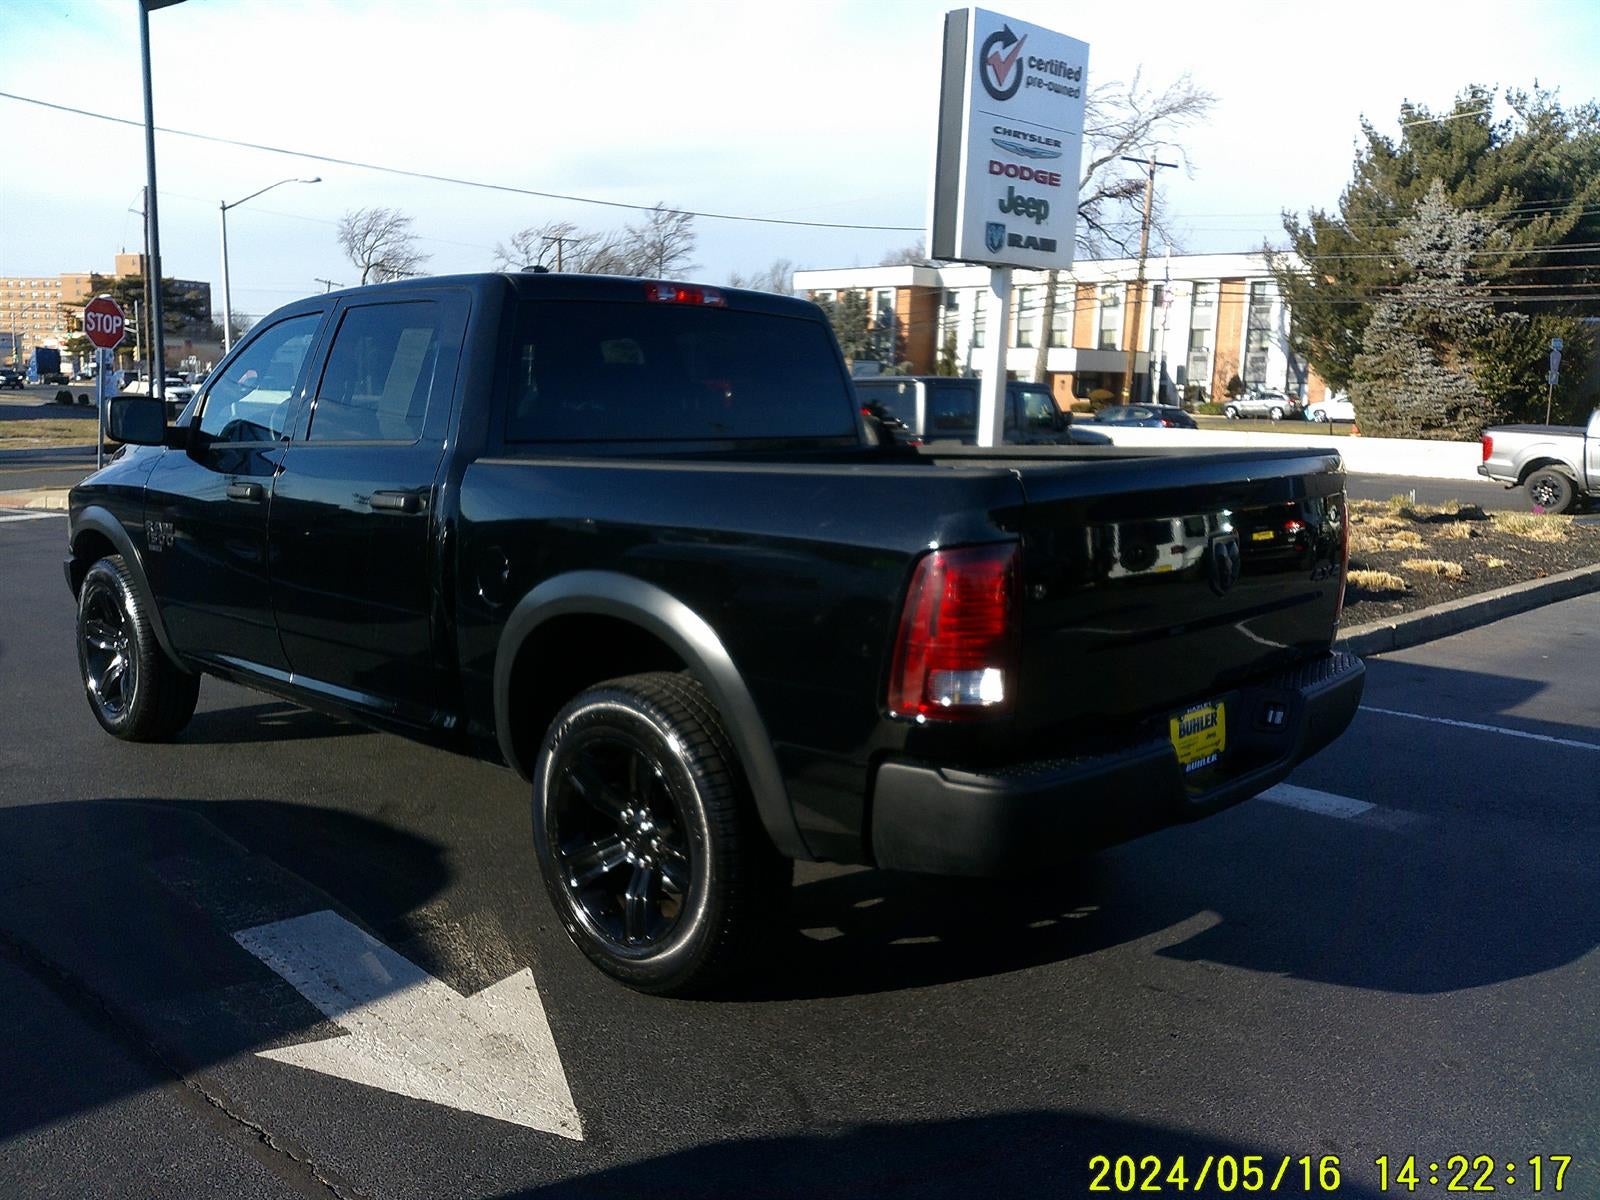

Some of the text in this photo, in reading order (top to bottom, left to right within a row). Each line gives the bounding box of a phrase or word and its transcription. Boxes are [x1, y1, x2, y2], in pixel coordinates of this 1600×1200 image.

[1027, 55, 1082, 82] certified
[1025, 74, 1080, 99] pre-owned
[993, 126, 1062, 148] CHRYSLER
[988, 159, 1061, 187] DODGE
[998, 186, 1049, 224] Jeep
[1007, 232, 1057, 252] RAM
[86, 311, 122, 334] STOP
